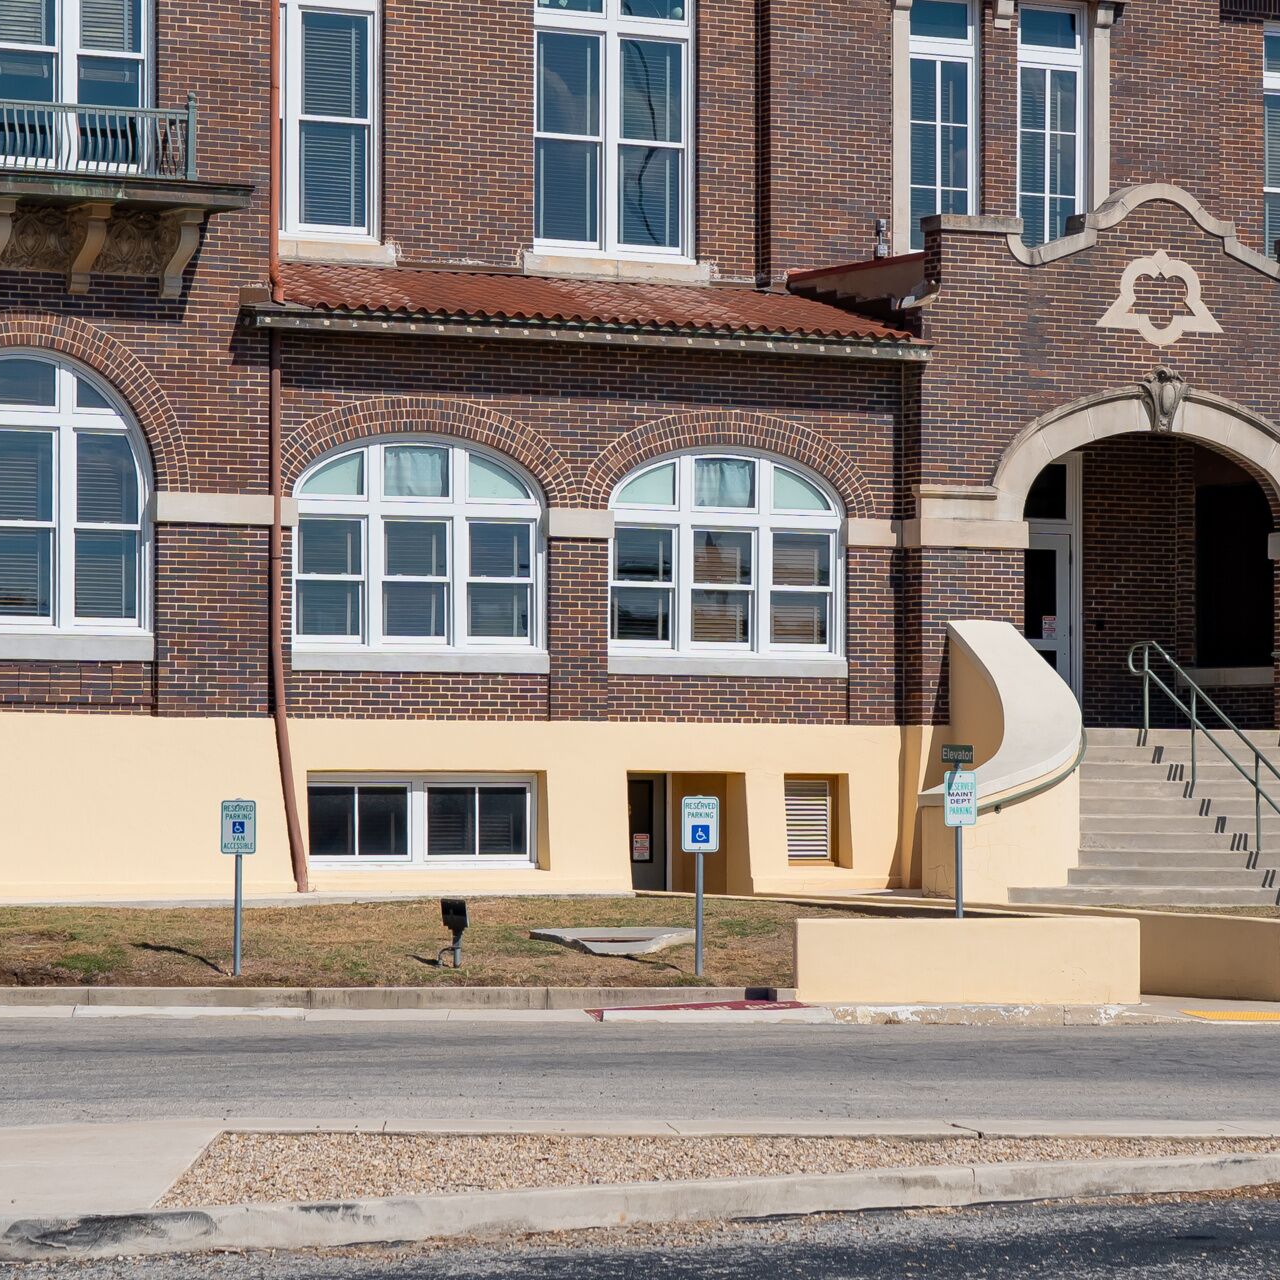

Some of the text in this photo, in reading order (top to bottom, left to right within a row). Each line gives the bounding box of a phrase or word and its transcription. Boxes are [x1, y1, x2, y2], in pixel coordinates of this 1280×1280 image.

[942, 748, 973, 760] Elevator
[224, 804, 253, 812] RESERVED
[685, 802, 715, 810] RESERVED
[950, 807, 972, 815] PARKING
[225, 813, 252, 821] PARKING
